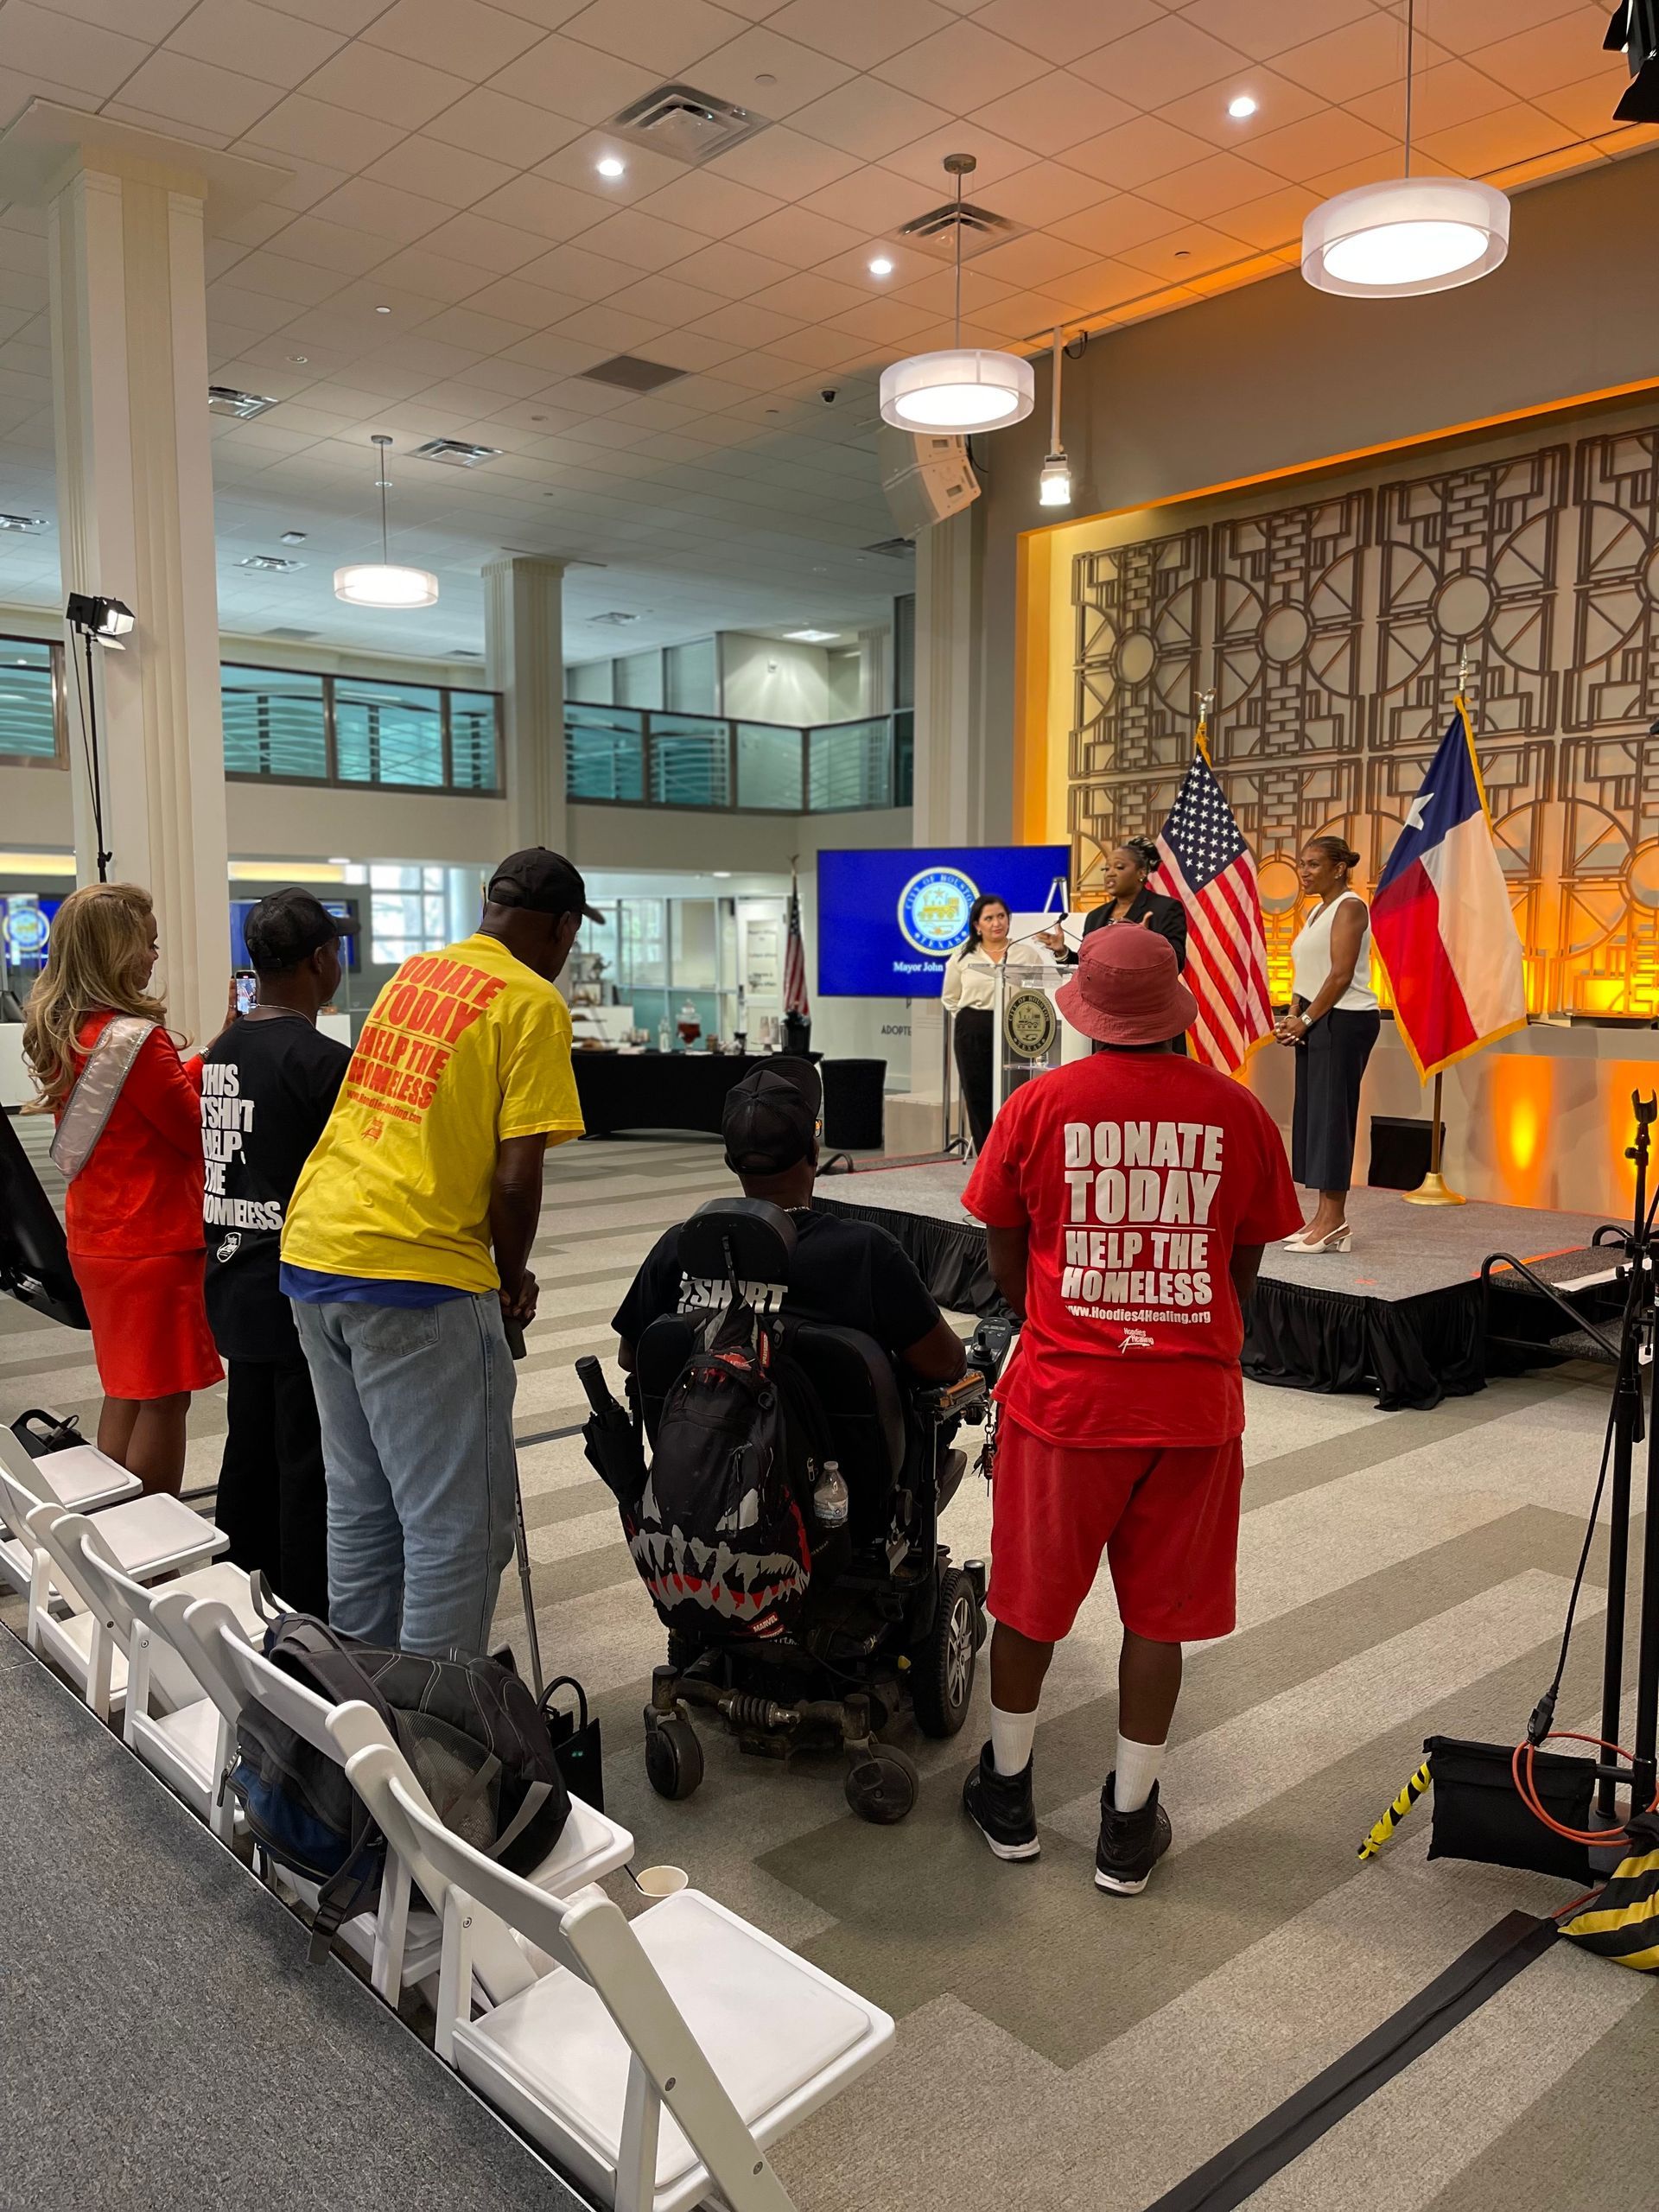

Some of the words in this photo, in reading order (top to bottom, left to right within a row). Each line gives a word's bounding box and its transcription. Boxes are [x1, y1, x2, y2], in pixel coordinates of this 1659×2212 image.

[923, 875, 935, 886] OF
[919, 934, 963, 949] TEXAS
[396, 956, 508, 1010] DONATE
[893, 961, 922, 975] Mayor
[923, 961, 944, 972] John
[372, 983, 484, 1045] TODAY
[356, 1025, 410, 1066] HELP
[405, 1040, 451, 1081] THE
[1017, 1041, 1042, 1052] TEXAS
[201, 1063, 240, 1097] THIS
[347, 1056, 438, 1110] HOMELESS
[200, 1096, 256, 1134] TSHIT
[1064, 1121, 1224, 1172] DONATE
[1064, 1168, 1222, 1225] TODAY
[1065, 1230, 1143, 1269] HELP
[1151, 1231, 1209, 1270] THE
[1061, 1266, 1213, 1307] HOMELESS
[753, 1614, 778, 1632] MARVEL
